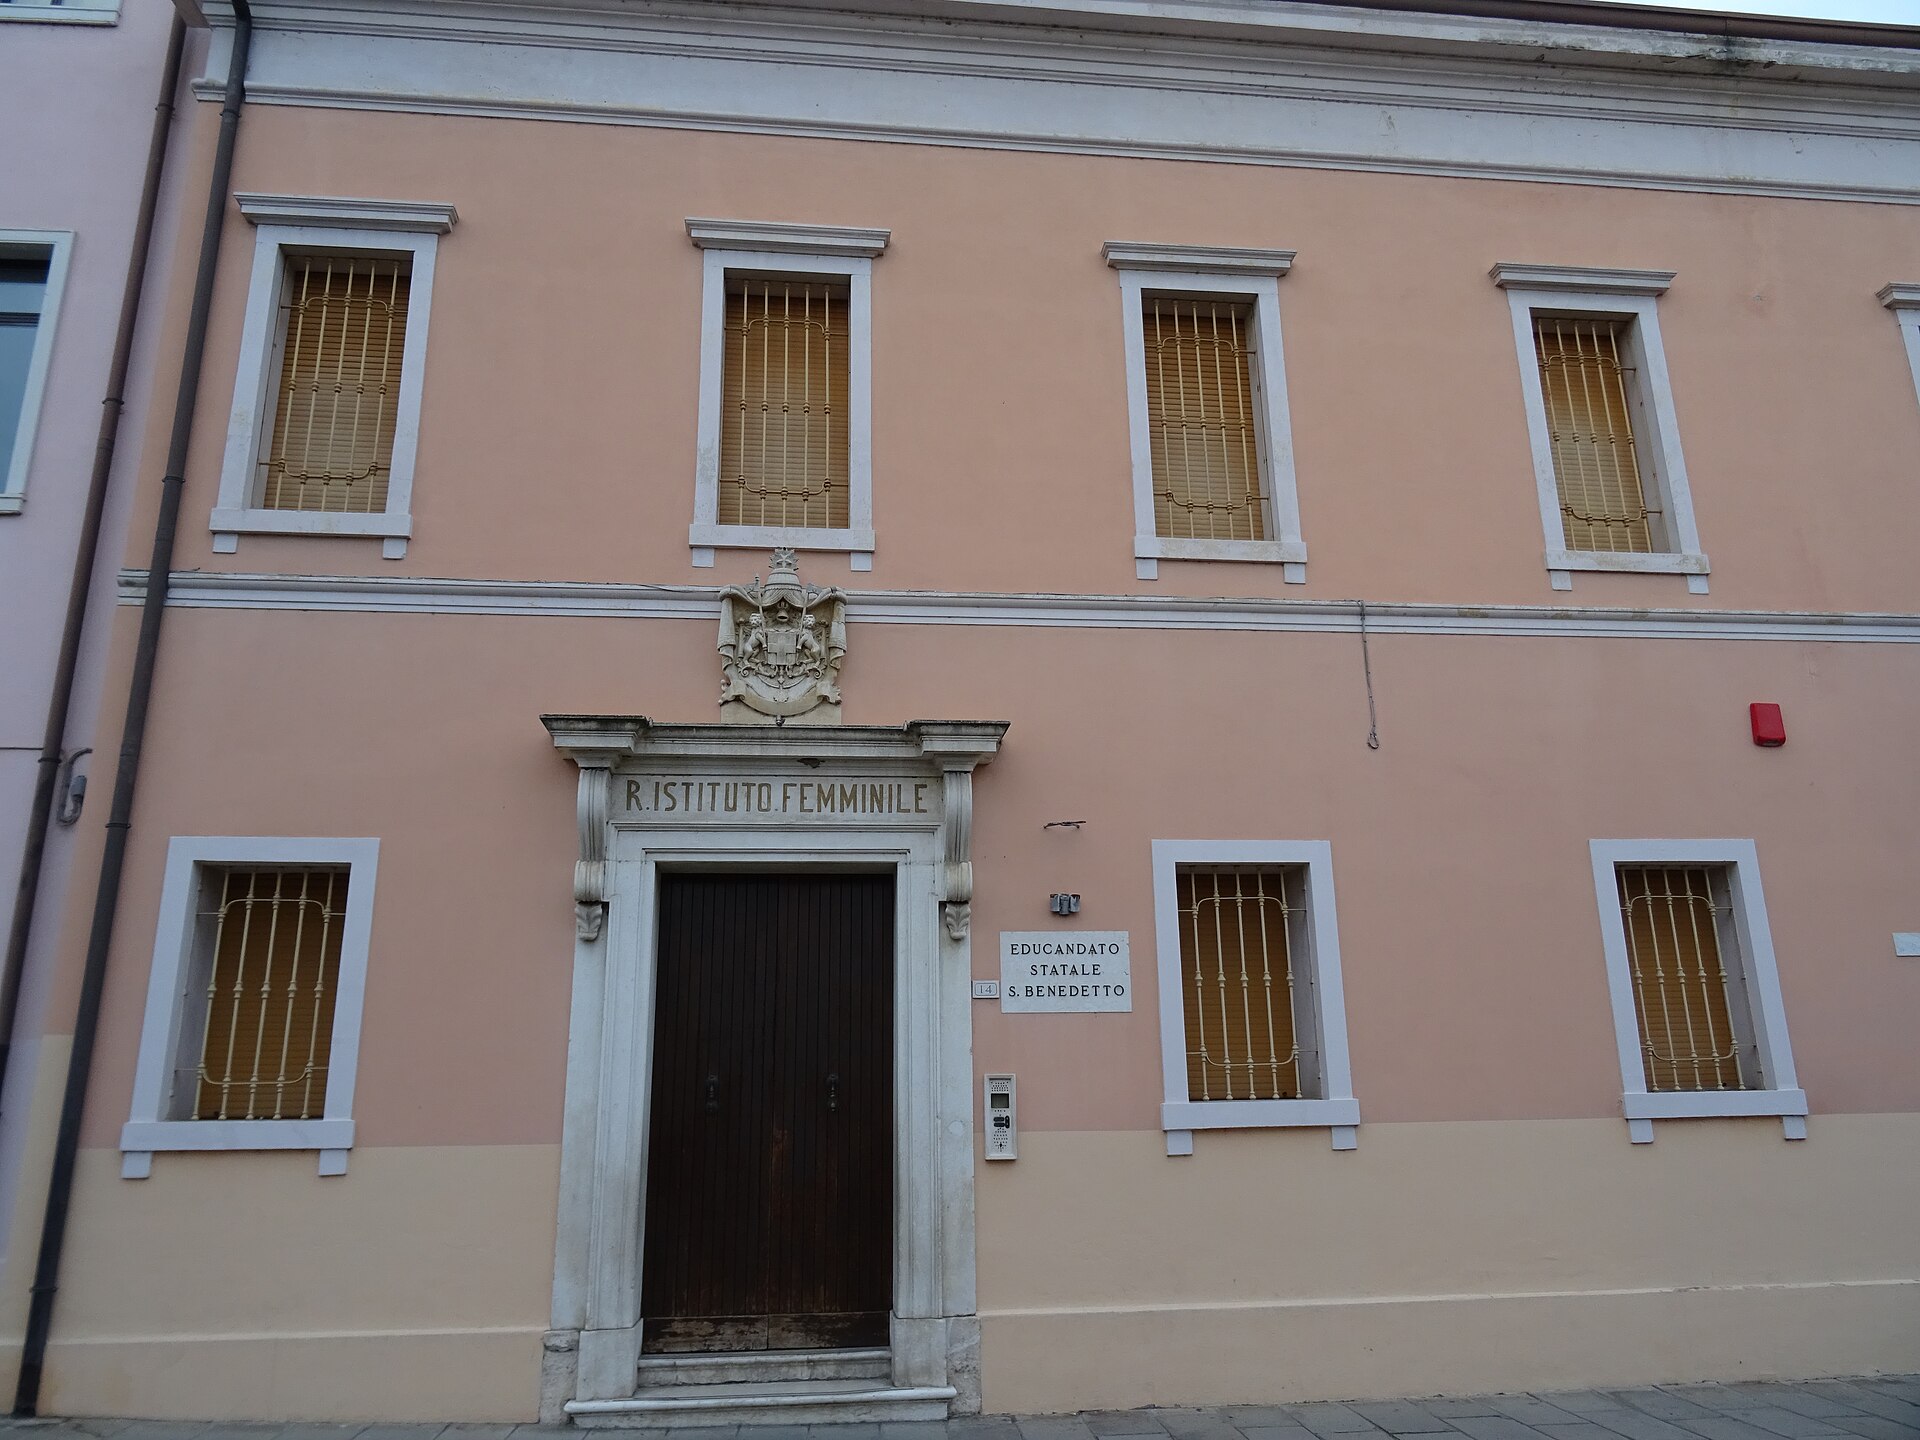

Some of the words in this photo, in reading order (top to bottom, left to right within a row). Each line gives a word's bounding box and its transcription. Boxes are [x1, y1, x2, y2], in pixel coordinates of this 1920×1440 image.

[782, 783, 928, 813] FEMMINILE
[1010, 943, 1120, 955] EDUCANDATO
[1030, 963, 1101, 976] STATALE
[1008, 985, 1020, 997] S.
[1025, 984, 1125, 997] BENEDETTO
